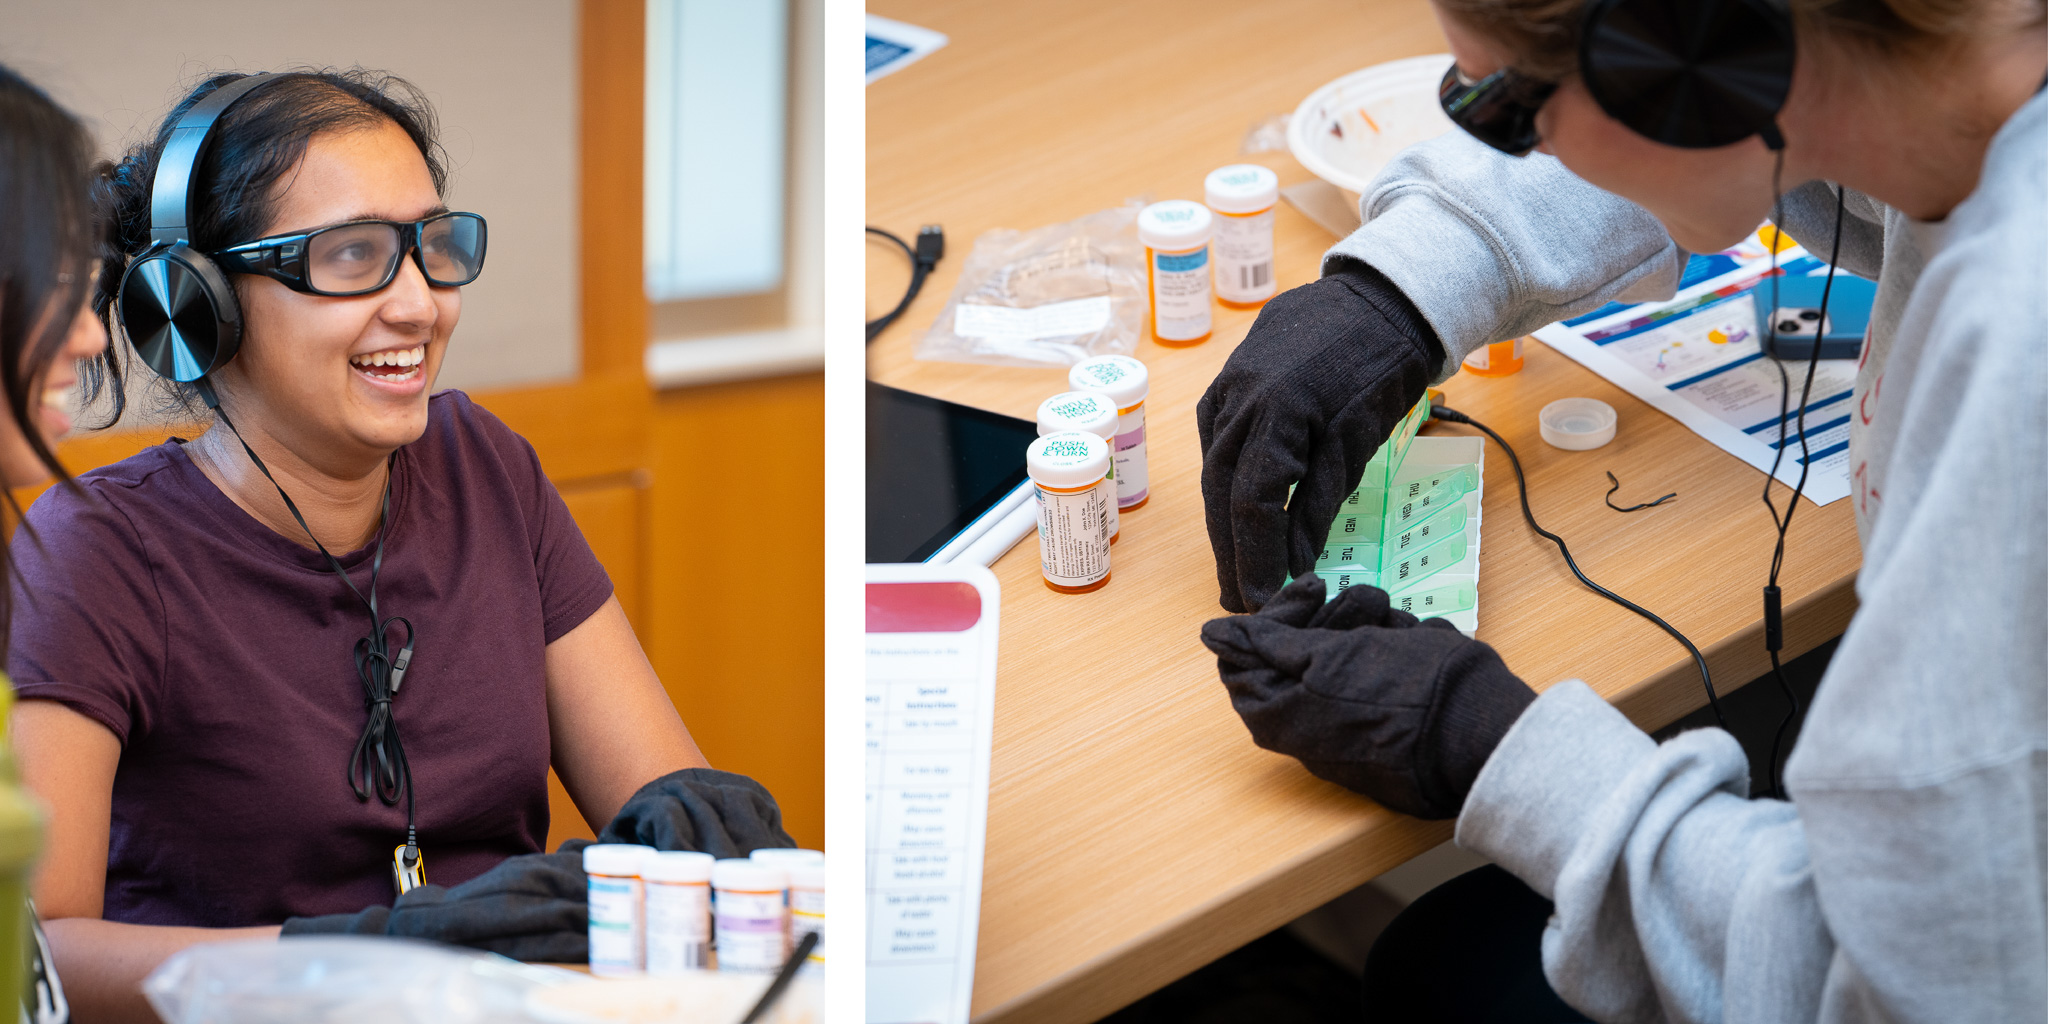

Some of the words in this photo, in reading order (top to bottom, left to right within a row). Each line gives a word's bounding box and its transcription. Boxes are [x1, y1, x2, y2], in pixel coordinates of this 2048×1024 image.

[1410, 482, 1419, 497] THU
[1349, 491, 1359, 504] THU
[1423, 496, 1430, 506] am
[1402, 503, 1412, 520] WED
[1345, 518, 1356, 532] WED
[1422, 526, 1430, 536] am
[1401, 532, 1410, 548] TUE
[1342, 547, 1353, 561] TUE
[1421, 556, 1428, 566] am
[1400, 561, 1409, 579] MON
[1338, 575, 1350, 591] MON
[1401, 597, 1412, 612] SUN
[1426, 596, 1433, 605] am
